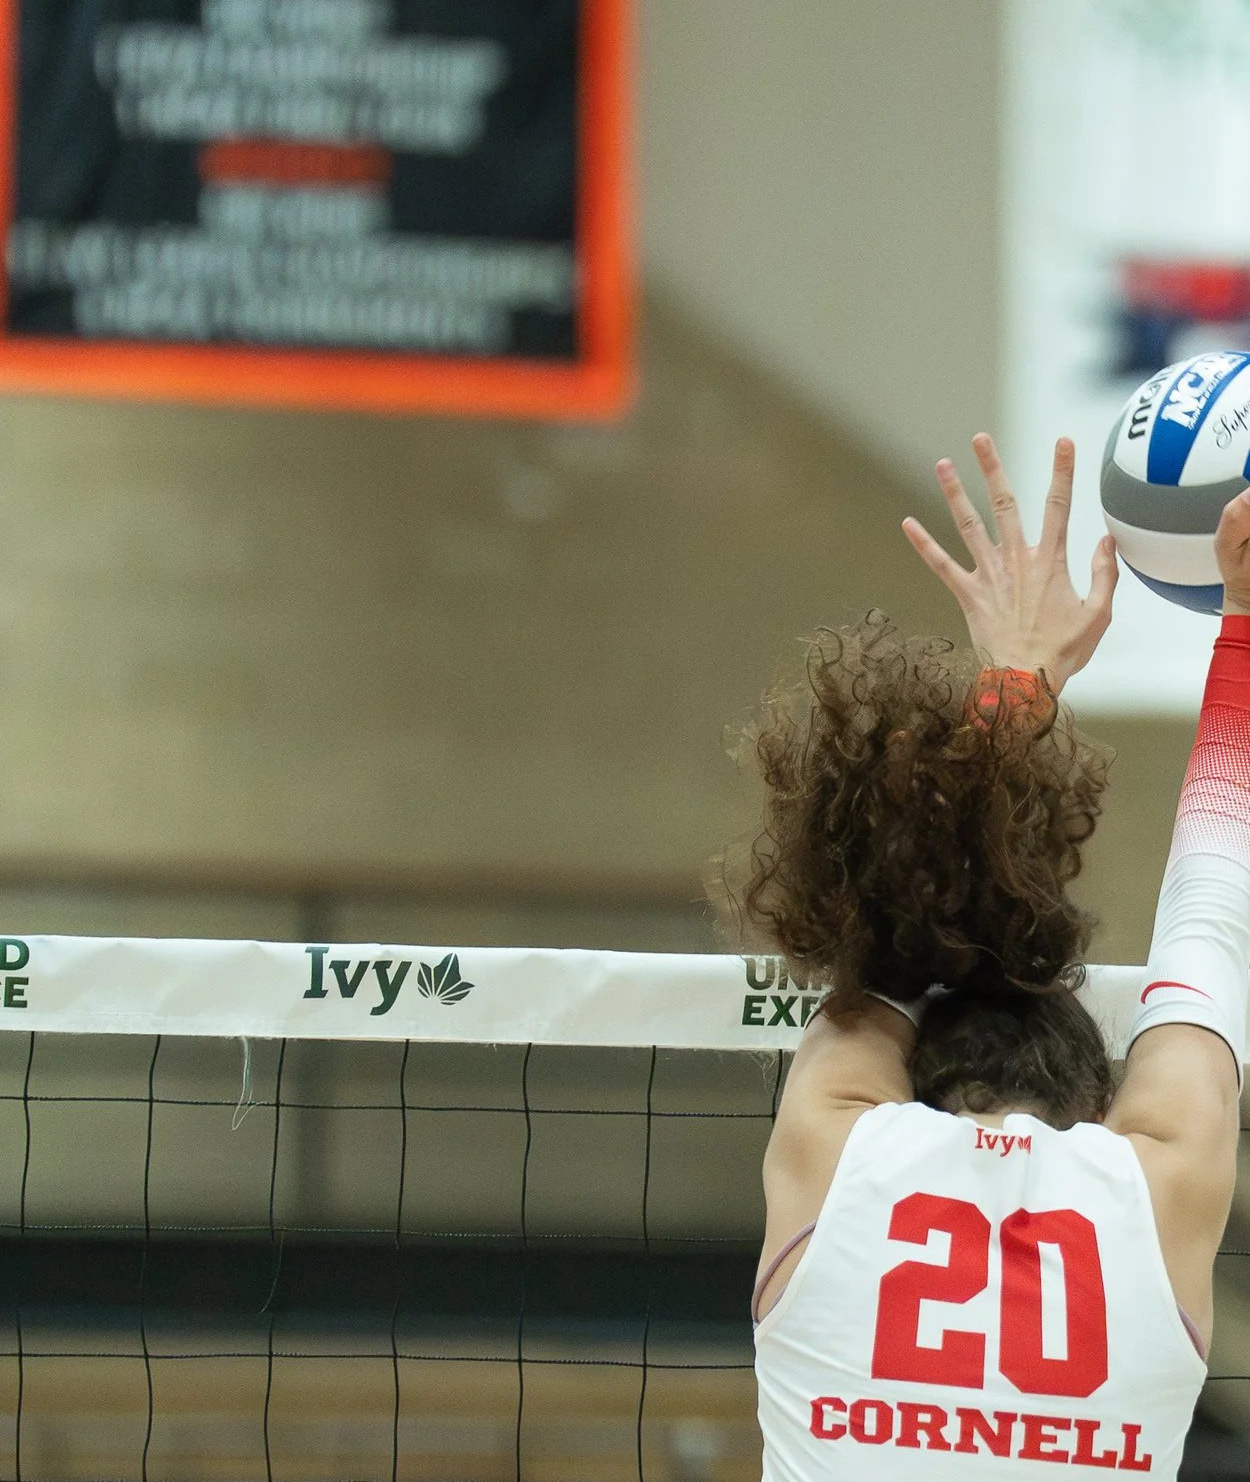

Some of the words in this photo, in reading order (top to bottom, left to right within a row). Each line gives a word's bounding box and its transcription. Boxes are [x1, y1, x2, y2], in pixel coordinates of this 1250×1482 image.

[1161, 353, 1248, 427] NCAA
[303, 946, 412, 1016] Ivy
[975, 1127, 1016, 1157] Ivy
[871, 1191, 1108, 1399] 20
[810, 1396, 1153, 1473] CORNELL
